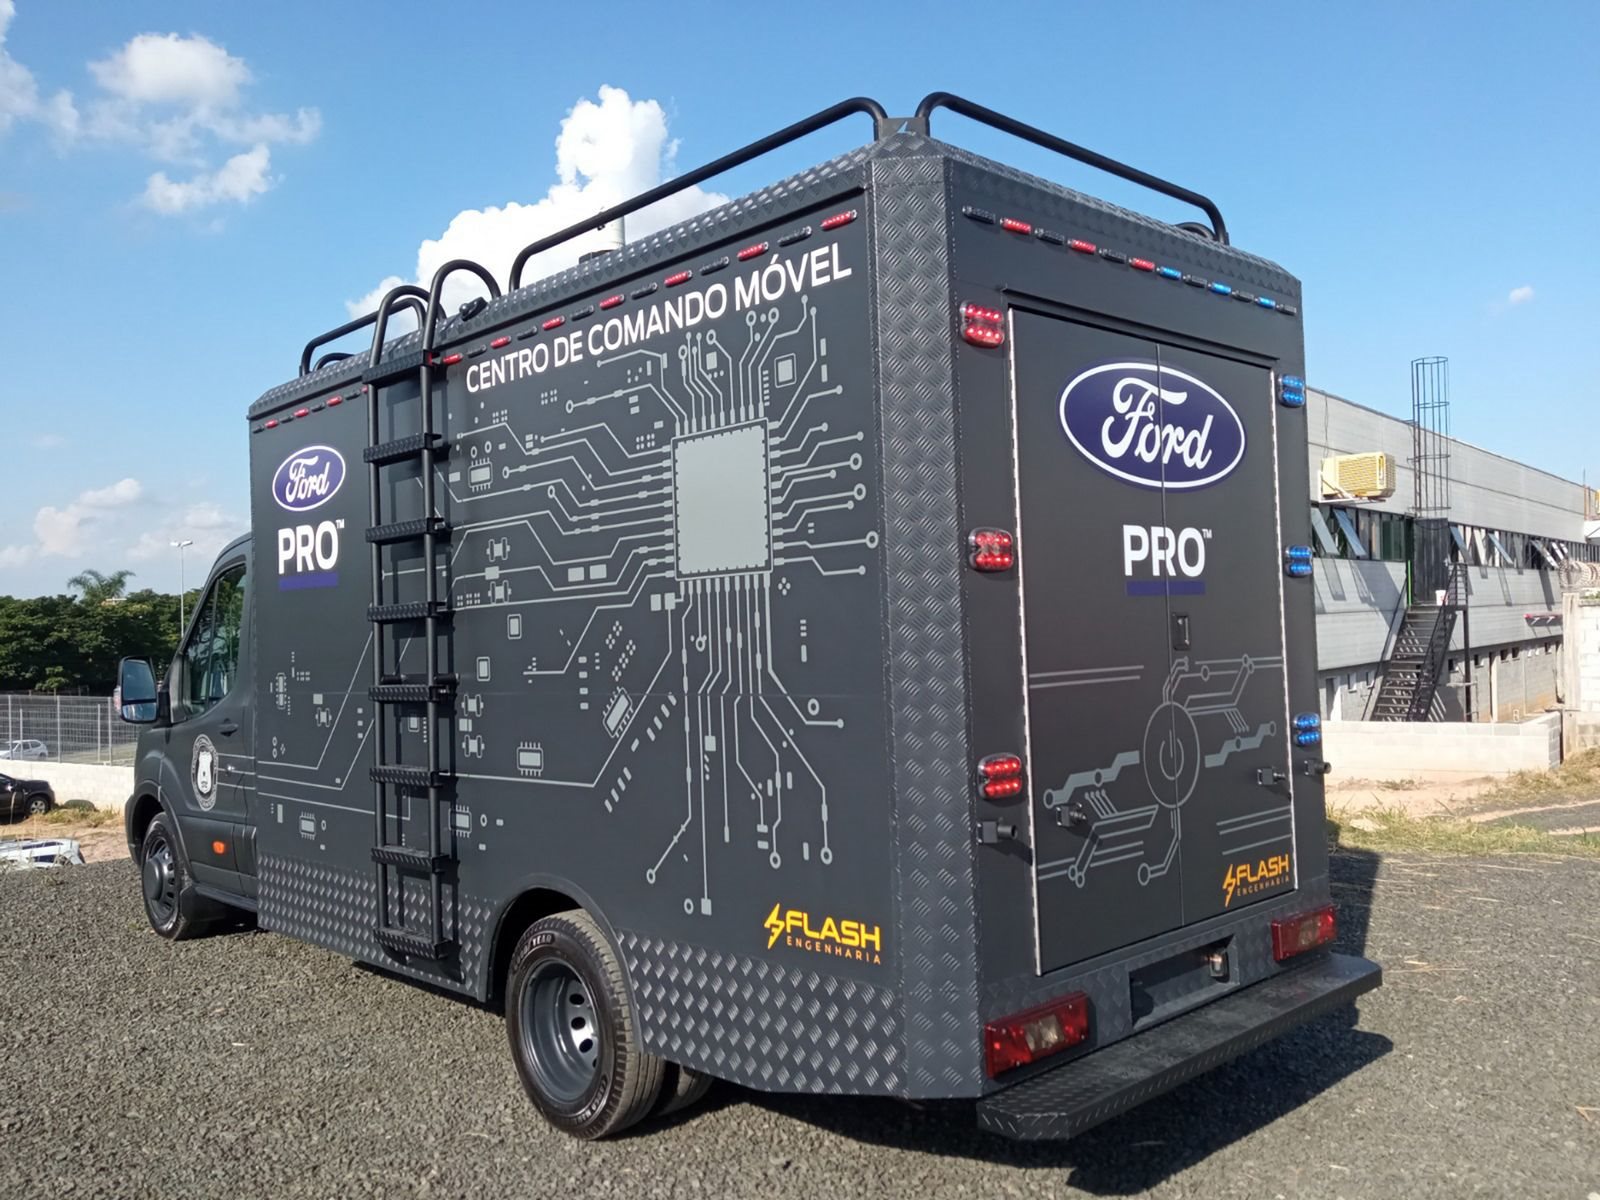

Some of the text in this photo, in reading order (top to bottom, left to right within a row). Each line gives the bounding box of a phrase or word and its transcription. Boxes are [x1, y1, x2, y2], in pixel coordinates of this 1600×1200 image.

[466, 242, 852, 393] CENTRO DE COMANDO MÓVEL
[1101, 377, 1214, 470] Ford
[285, 455, 331, 503] Ford
[1236, 853, 1290, 886] FLASH
[785, 910, 880, 952] FLASH
[786, 935, 881, 965] ENGENHARIA
